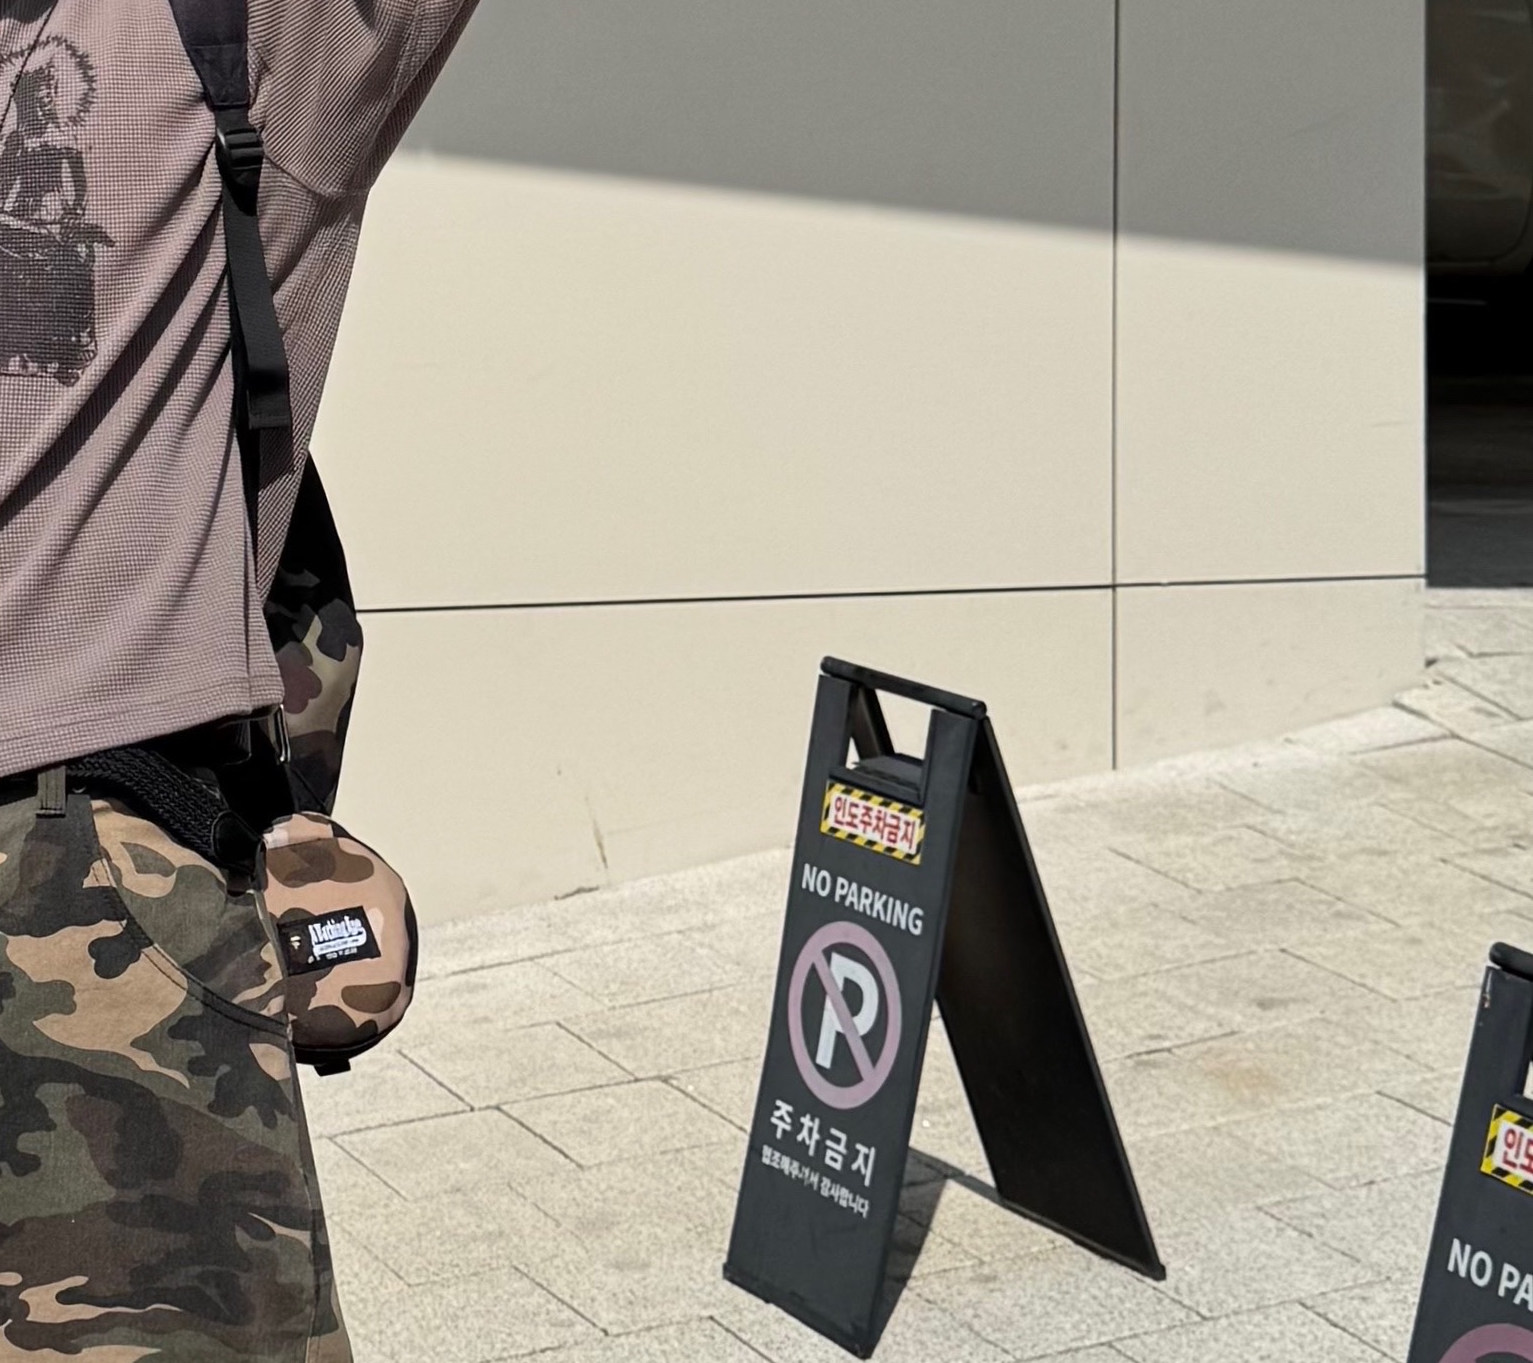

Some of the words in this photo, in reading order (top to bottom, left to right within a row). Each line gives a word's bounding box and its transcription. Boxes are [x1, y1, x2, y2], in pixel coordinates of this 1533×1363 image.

[834, 796, 916, 850] 인도주차금지
[801, 863, 832, 897] NO
[835, 876, 924, 936] PARKING
[770, 1099, 876, 1187] 주차금지
[1447, 1238, 1493, 1287] NO
